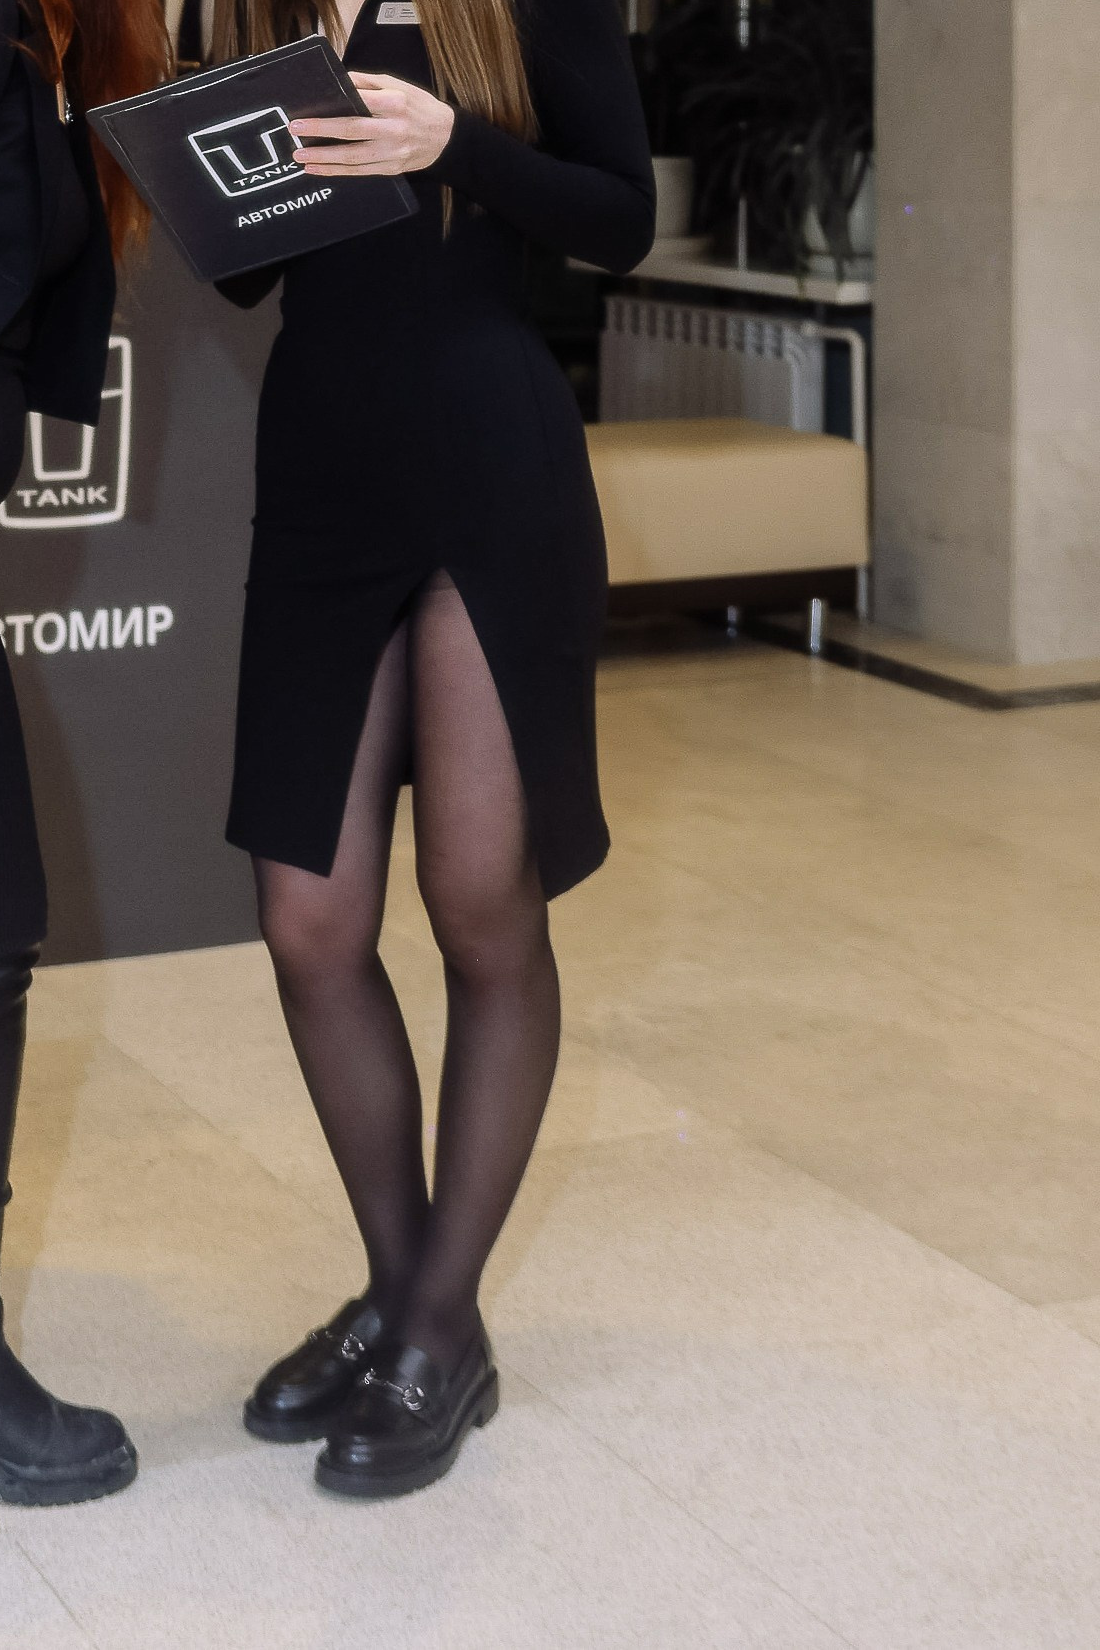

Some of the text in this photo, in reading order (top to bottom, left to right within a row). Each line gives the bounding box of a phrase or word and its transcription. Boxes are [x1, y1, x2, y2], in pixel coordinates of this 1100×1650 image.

[233, 161, 298, 186] TANK
[238, 188, 332, 227] АВТОМИР
[17, 486, 107, 507] TANK
